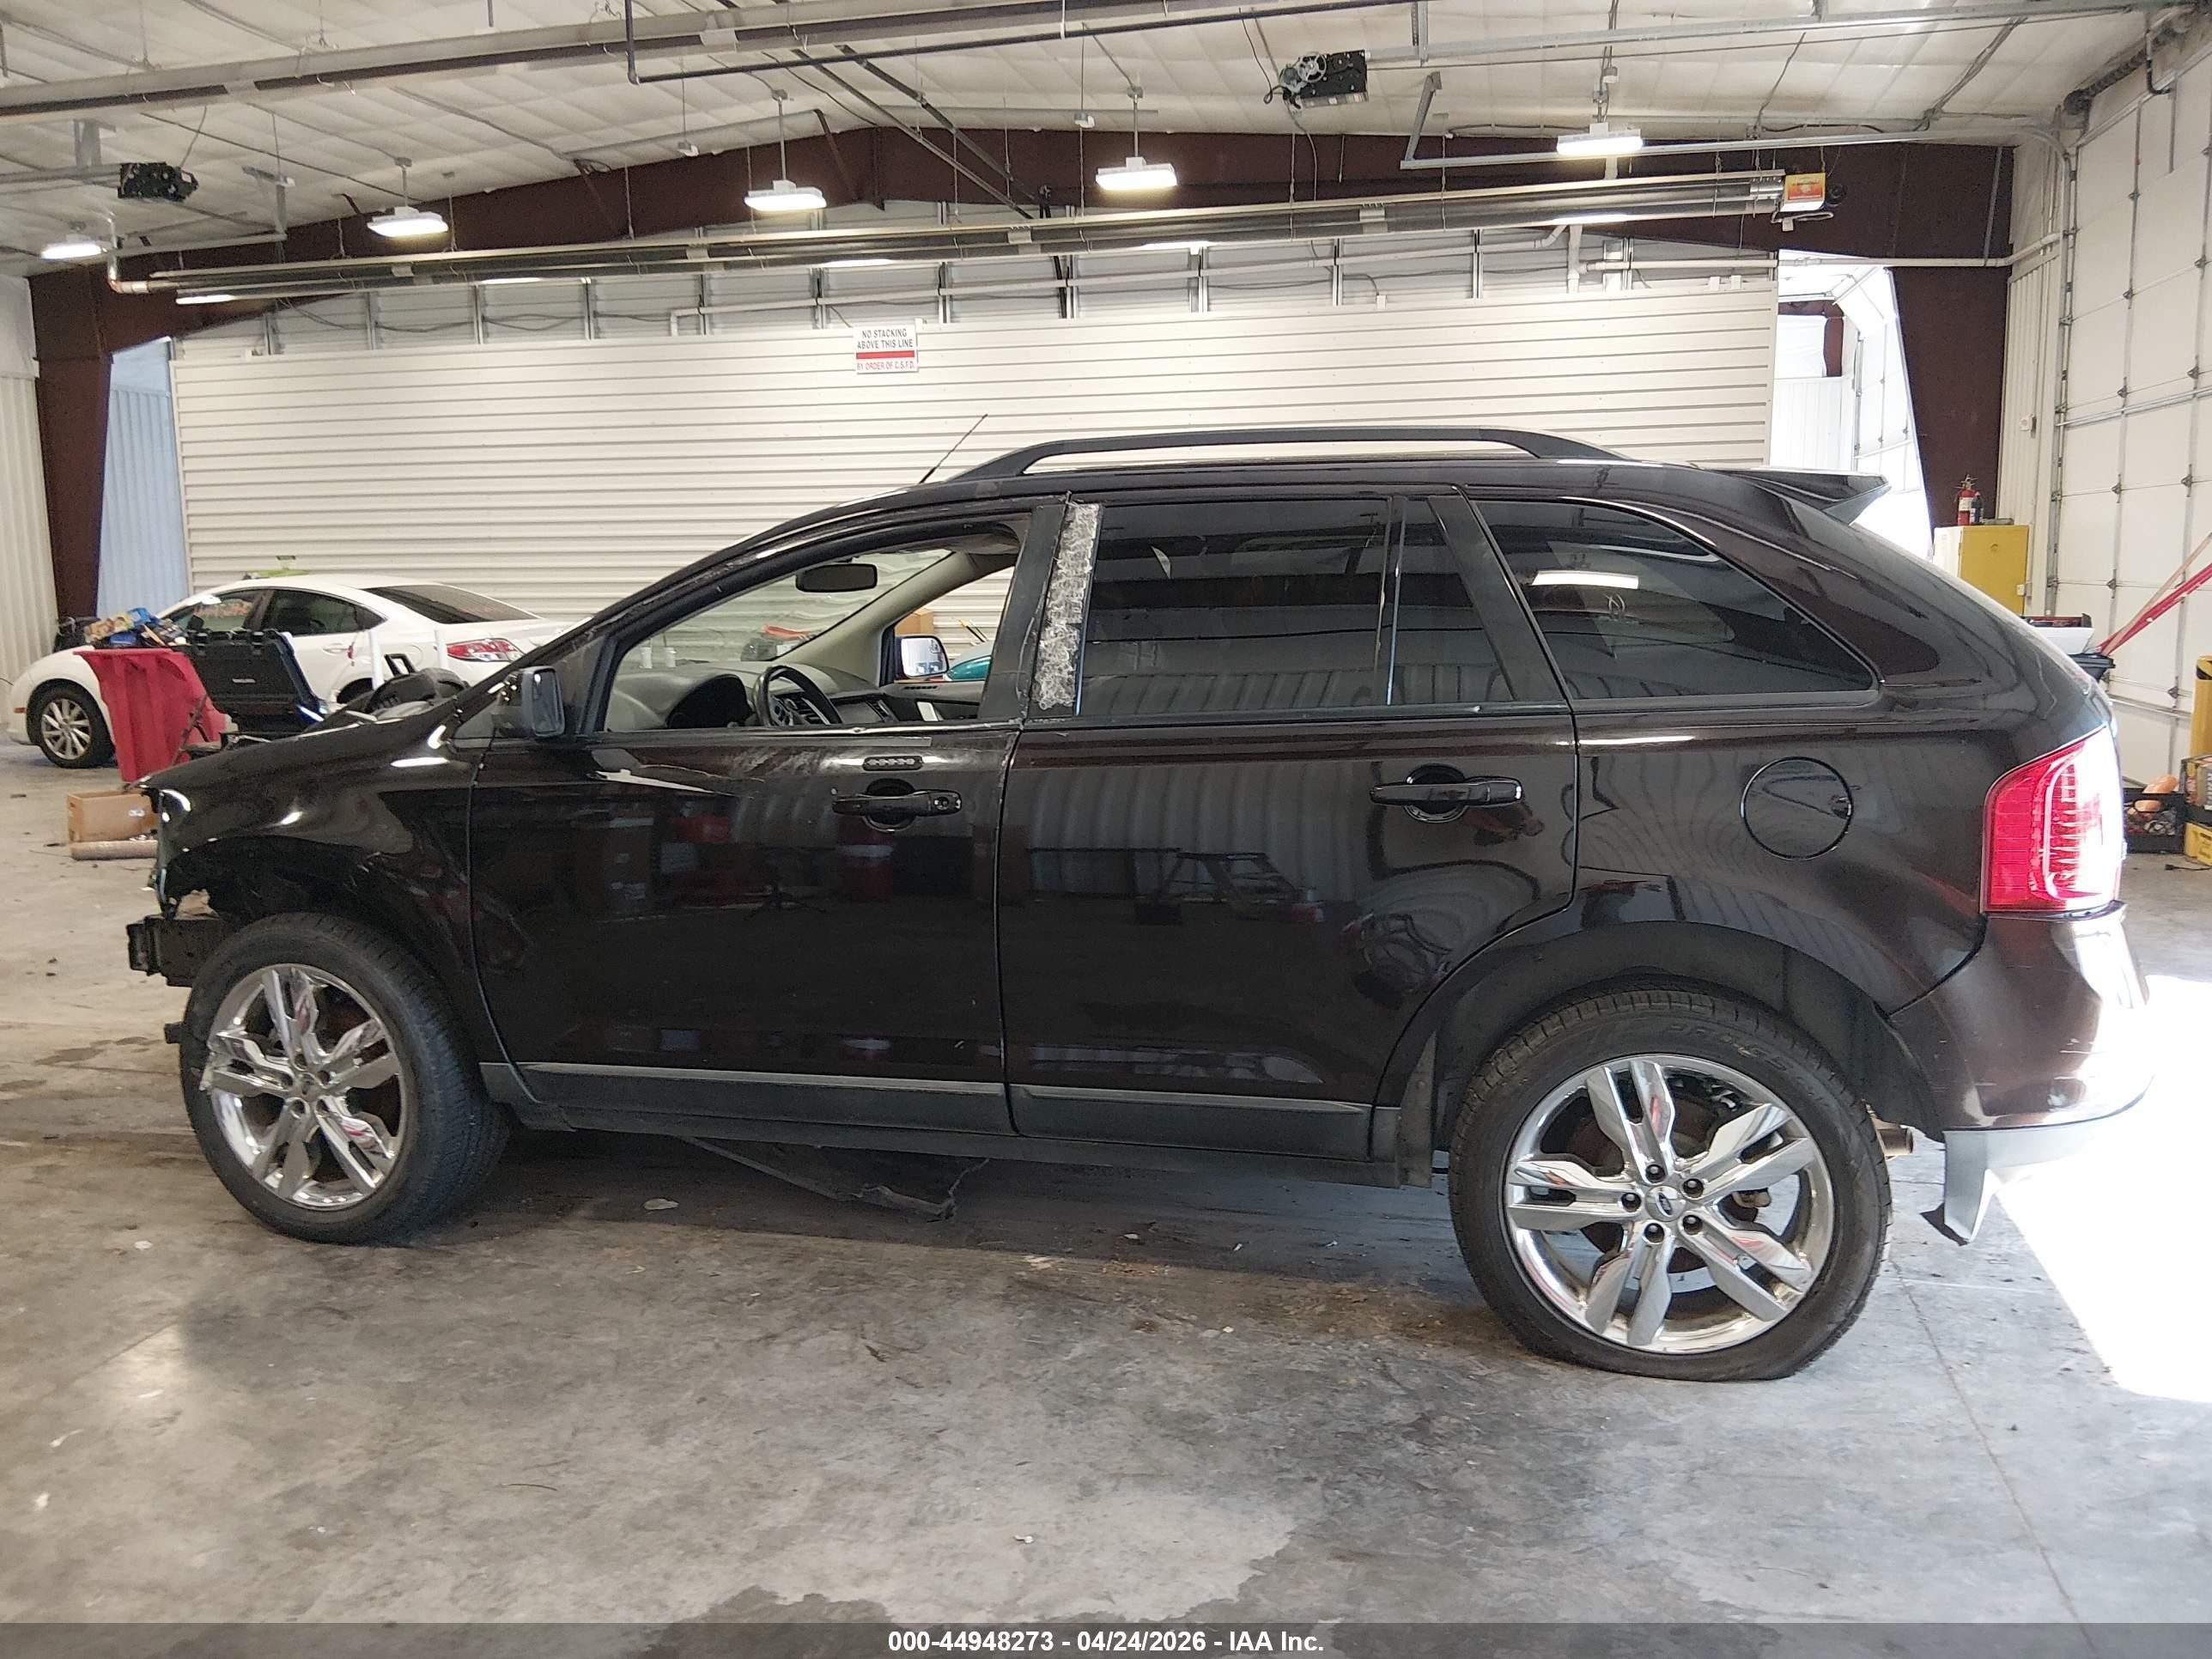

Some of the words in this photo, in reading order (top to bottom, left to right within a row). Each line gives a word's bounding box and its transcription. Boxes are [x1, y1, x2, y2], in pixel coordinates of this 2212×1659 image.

[861, 329, 872, 338] NO
[873, 328, 908, 338] STACKING
[857, 340, 879, 349] ABOVE
[881, 339, 896, 349] THIS
[897, 338, 914, 349] LINE
[866, 362, 884, 370] ORDER
[885, 361, 894, 370] OF
